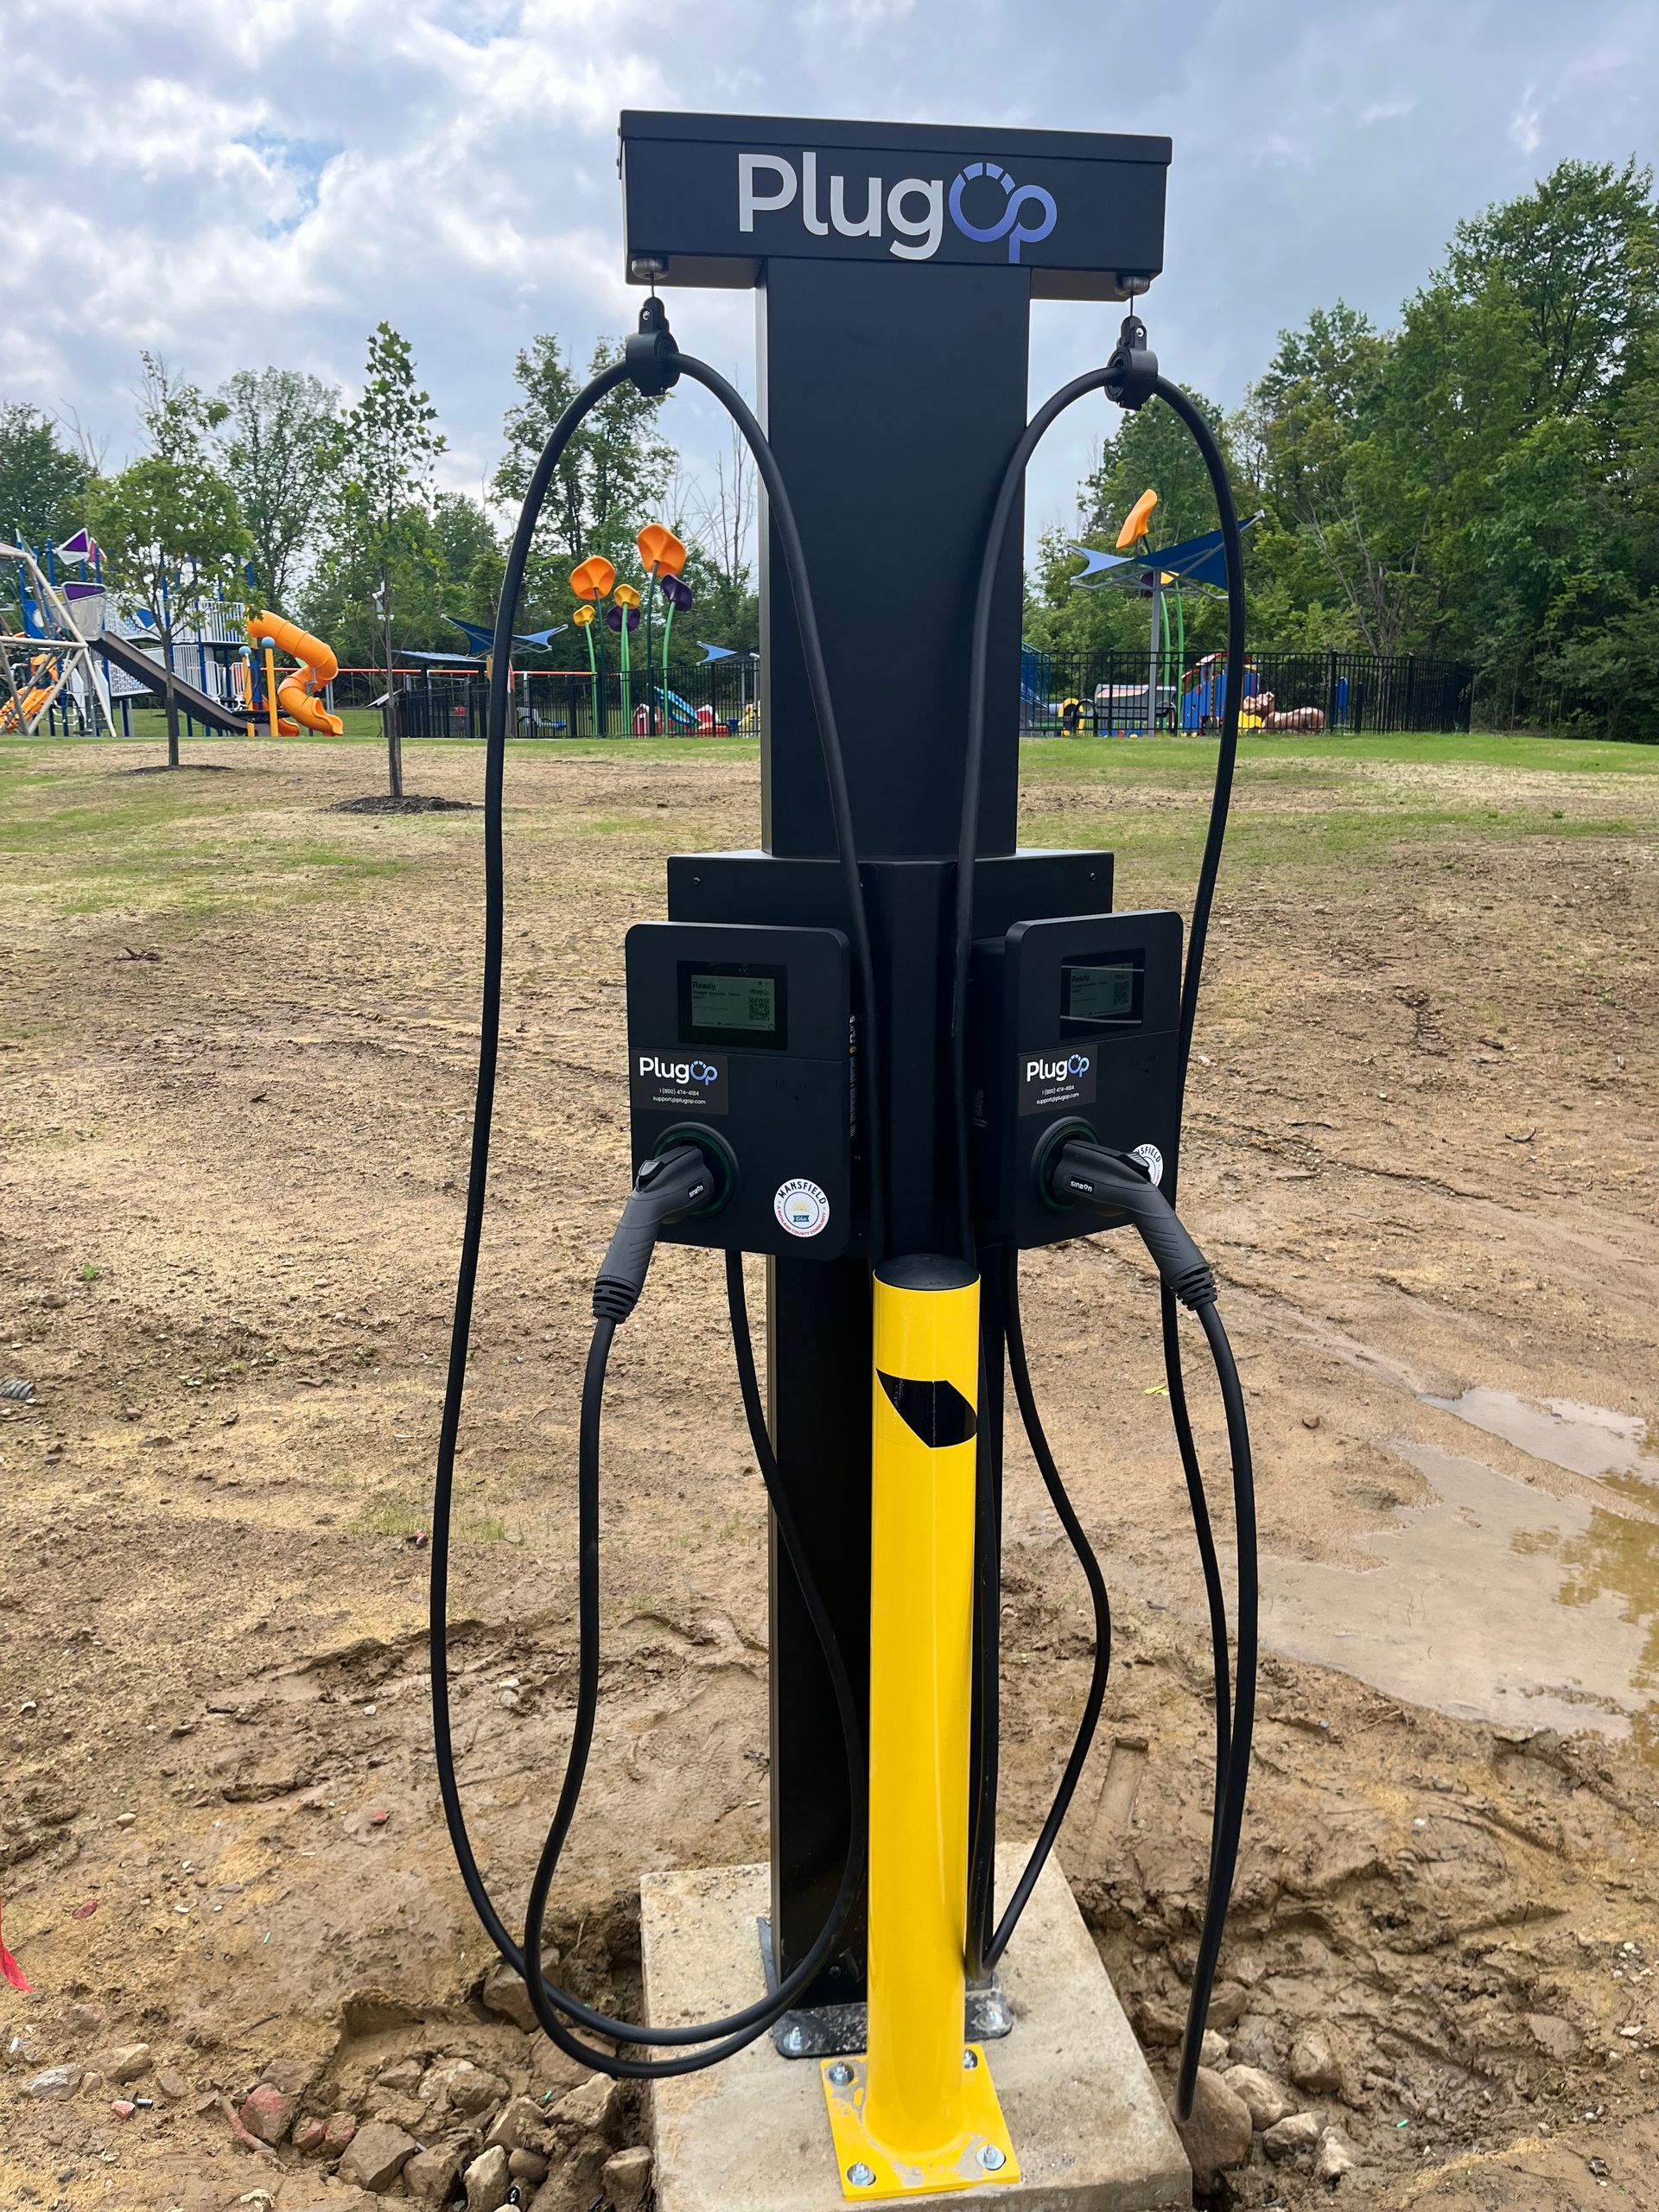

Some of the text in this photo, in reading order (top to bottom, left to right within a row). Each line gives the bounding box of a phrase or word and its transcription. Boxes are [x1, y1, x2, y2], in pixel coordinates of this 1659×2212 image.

[737, 152, 1058, 263] PlugOp
[693, 982, 716, 991] Ready
[639, 1057, 718, 1086] PlugOp
[1027, 1053, 1090, 1082] PlugOp
[652, 1096, 707, 1105] support@plugop.com
[662, 1087, 676, 1096] (800)
[1036, 1092, 1080, 1104] support@plugop.com
[777, 1180, 827, 1205] MANSFIELD
